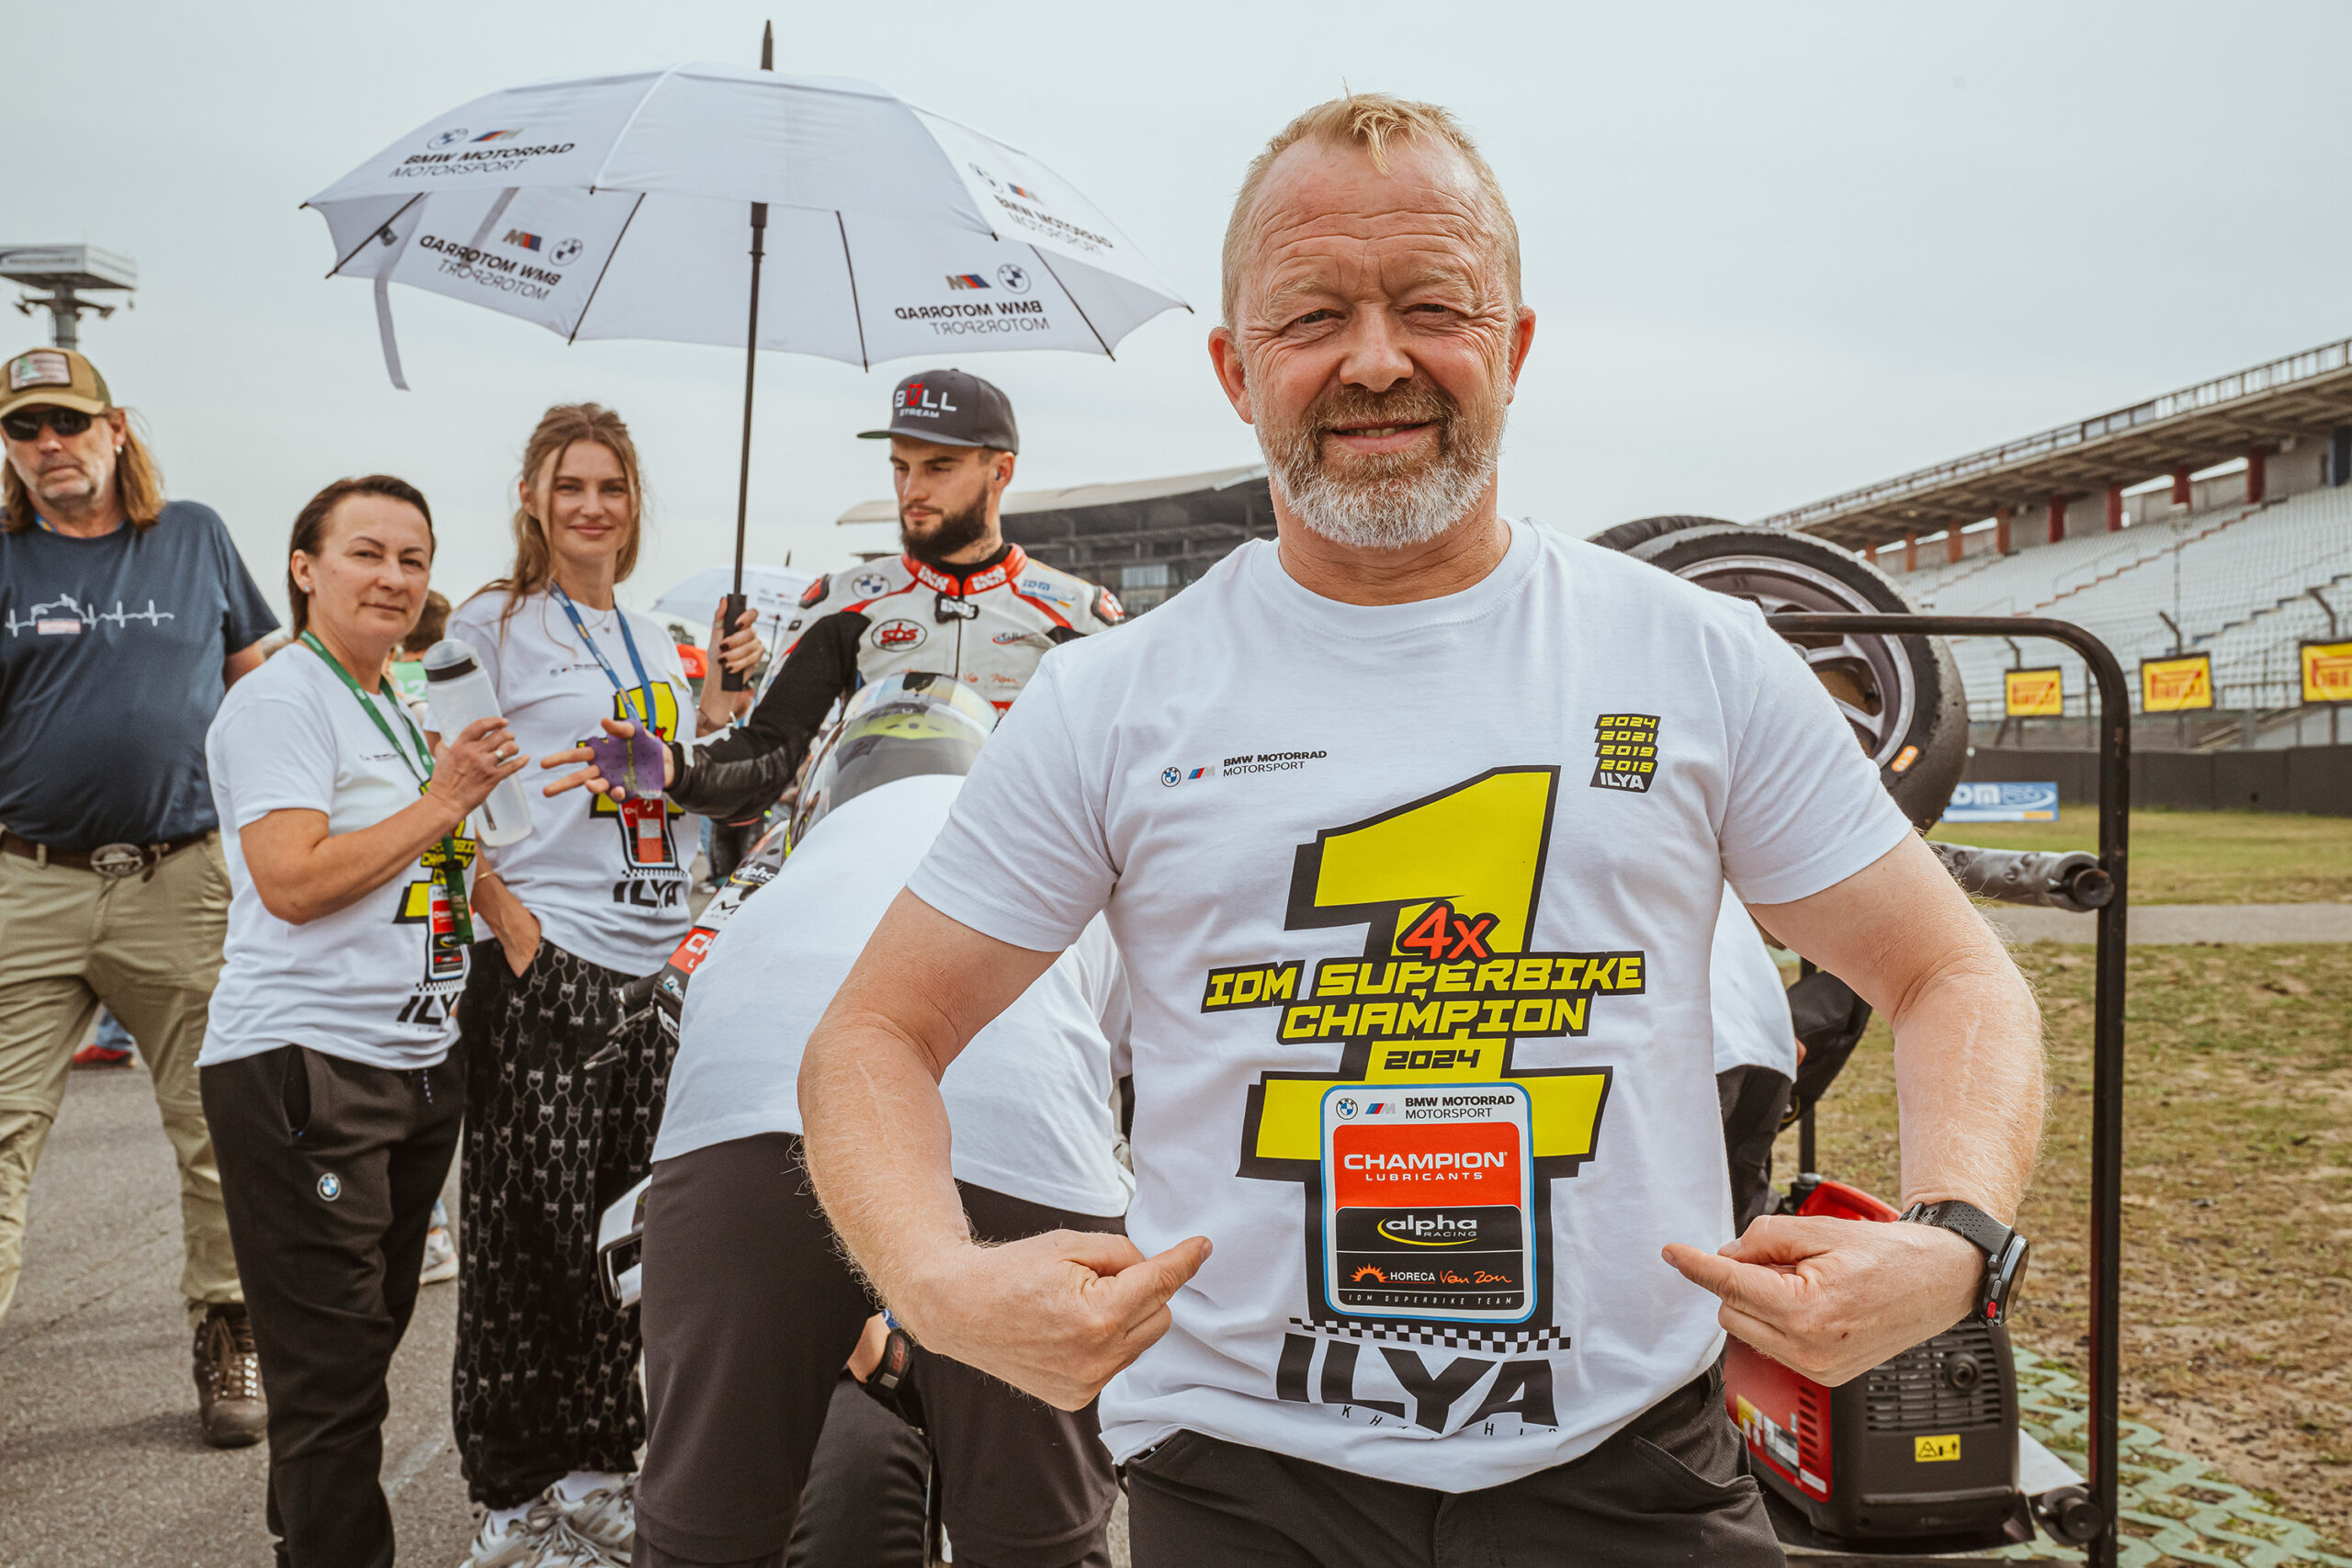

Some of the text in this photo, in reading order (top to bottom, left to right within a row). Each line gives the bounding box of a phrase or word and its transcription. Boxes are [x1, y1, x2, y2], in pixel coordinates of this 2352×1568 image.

[403, 143, 575, 165] BMW MOTORRAD
[388, 159, 529, 178] MOTORSPORT
[894, 382, 957, 412] BULL
[899, 408, 941, 419] STREAM
[1600, 716, 1657, 729] 2024
[1600, 730, 1655, 743] 2021
[1223, 750, 1329, 768] BMW MOTORRAD
[1600, 744, 1655, 758] 2019
[1223, 761, 1306, 778] MOTORSPORT
[1600, 759, 1655, 773] 2018
[1600, 772, 1645, 790] ILYA
[613, 878, 684, 909] ILYA
[1403, 907, 1493, 961] 4x
[1205, 957, 1644, 1008] IDM SUPERBIKE
[396, 991, 459, 1026] ILY
[1283, 998, 1588, 1040] CHAMPION
[1383, 1049, 1481, 1071] 2024
[1405, 1095, 1515, 1108] BMW MOTORRAD
[1405, 1107, 1493, 1120] MOTORSPORT
[1343, 1151, 1506, 1170] CHAMPION
[1365, 1171, 1484, 1181] LUBRICANTS
[1385, 1213, 1478, 1236] alpha
[1423, 1230, 1478, 1238] RACING
[1389, 1269, 1513, 1285] HORECA Van Zon
[1348, 1293, 1513, 1306] IDM SUPERBIKE TEAM
[1275, 1331, 1560, 1435] ILYA
